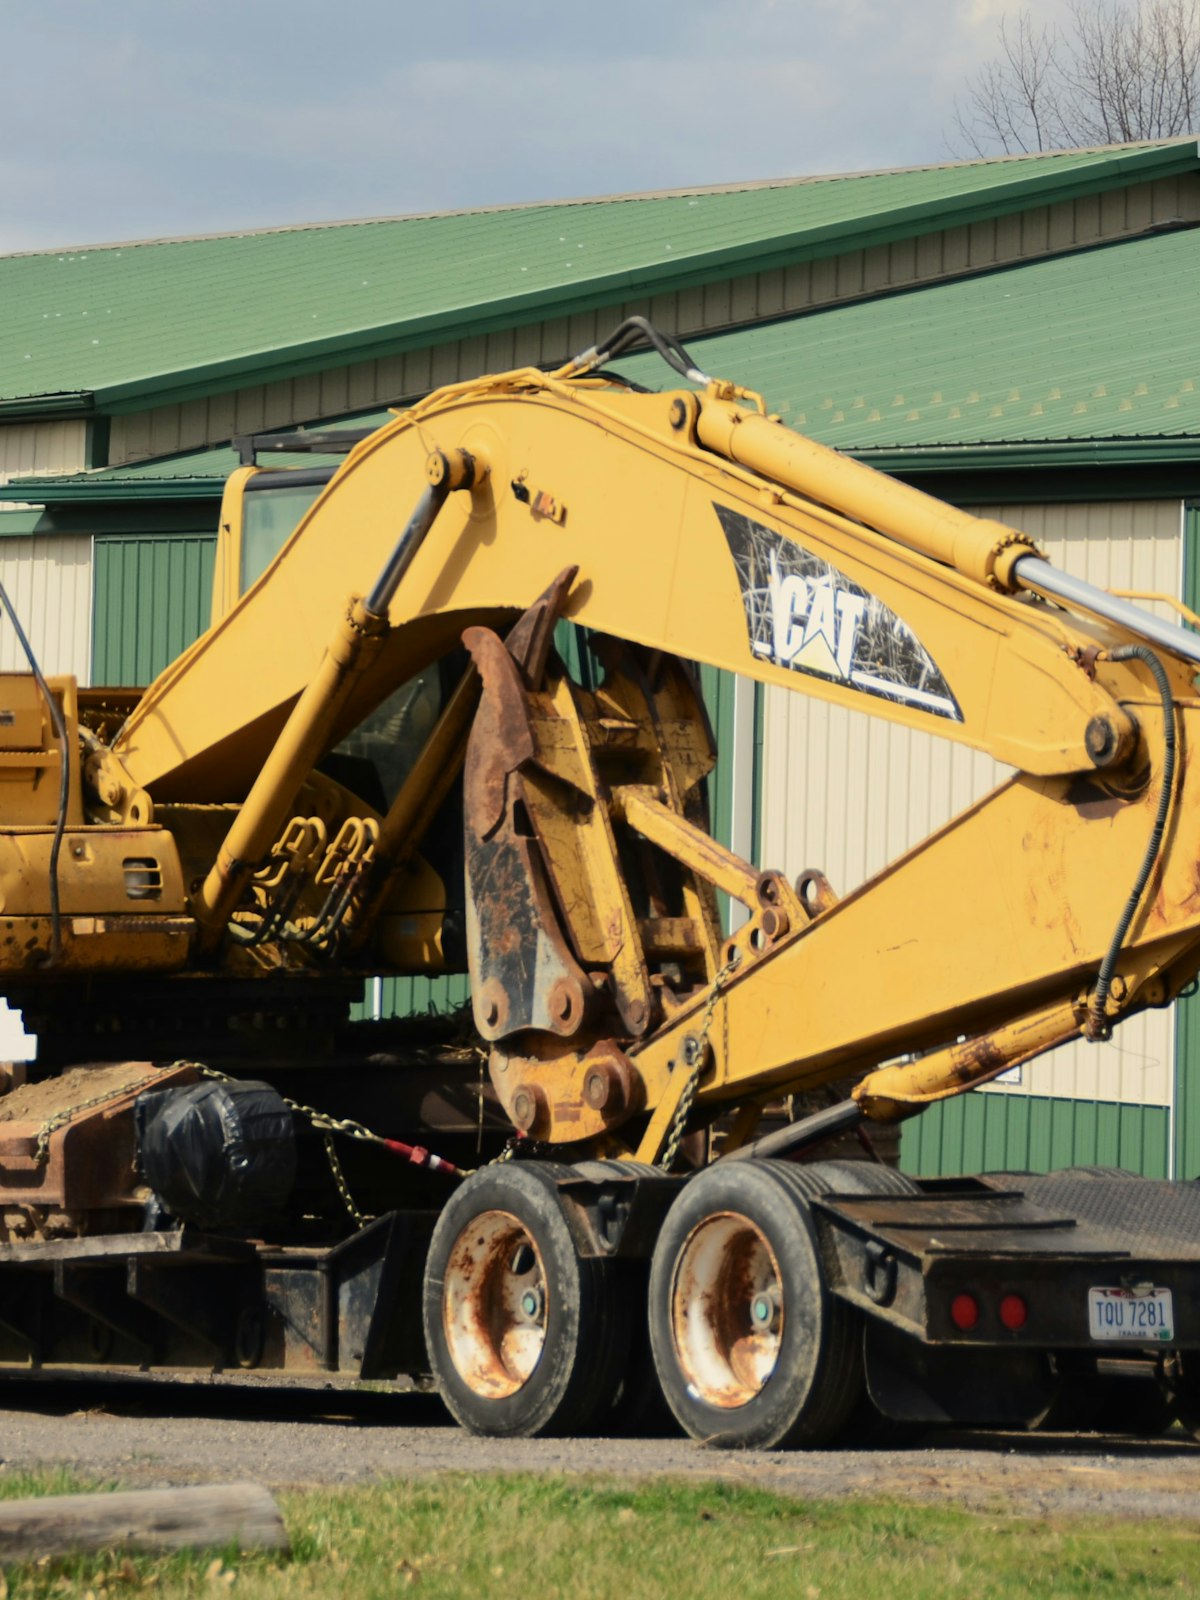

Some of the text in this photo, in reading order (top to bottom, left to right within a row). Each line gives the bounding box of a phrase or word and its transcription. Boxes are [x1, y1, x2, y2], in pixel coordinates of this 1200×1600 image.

[777, 574, 865, 679] CAT
[1096, 1301, 1166, 1327] TQU 7281
